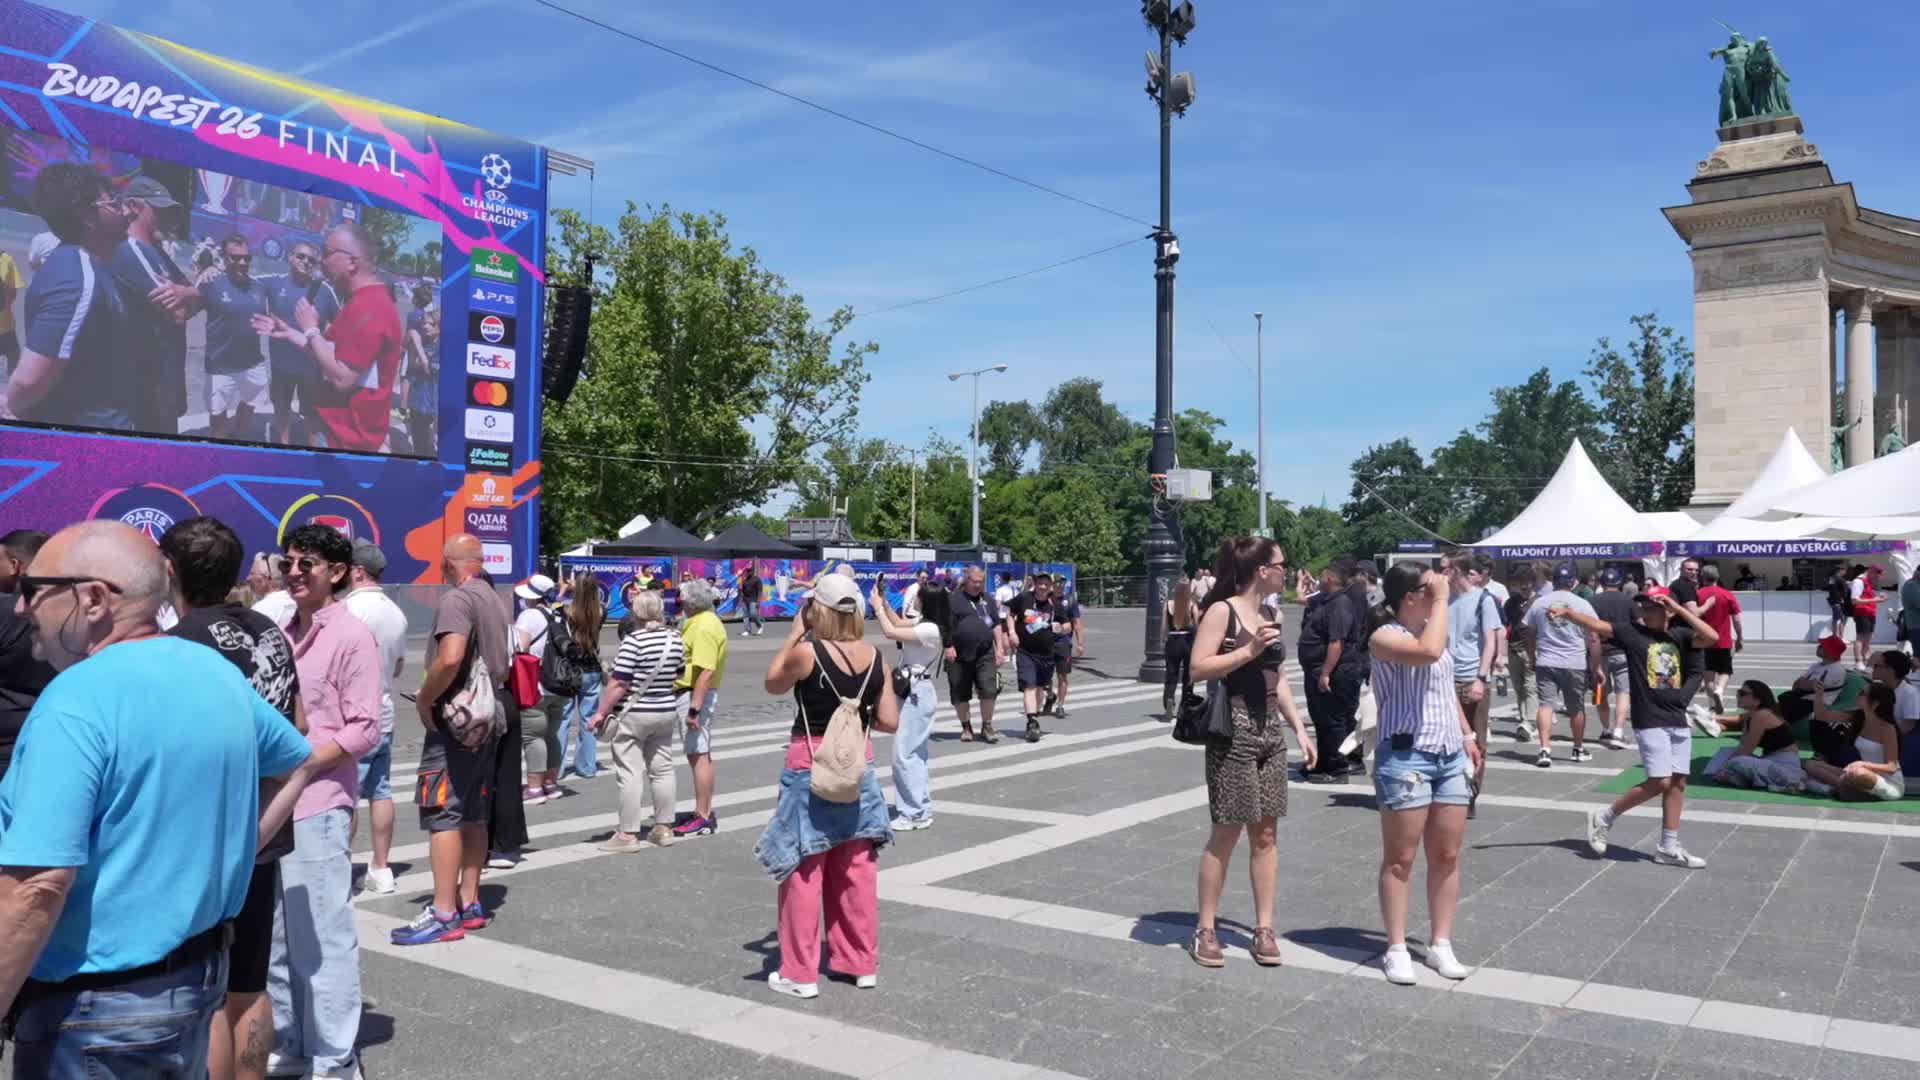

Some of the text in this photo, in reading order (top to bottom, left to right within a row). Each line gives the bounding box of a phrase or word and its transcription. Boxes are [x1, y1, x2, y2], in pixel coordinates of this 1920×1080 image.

[42, 63, 405, 178] BUDAPEST 26 FINAL
[462, 196, 528, 220] CHAMPIONS
[474, 210, 517, 228] LEAGUE
[487, 291, 515, 305] PS5
[472, 351, 512, 370] FedEx
[126, 511, 168, 526] PARIS
[468, 512, 507, 526] QATAR
[1501, 547, 1550, 557] ITALPONT
[1560, 545, 1612, 556] BEVERAGE
[1717, 543, 1774, 553] ITALPONT
[1784, 541, 1847, 553] BEVERAGE
[590, 565, 632, 573] CHAMPIONS
[634, 565, 663, 574] LEGUE
